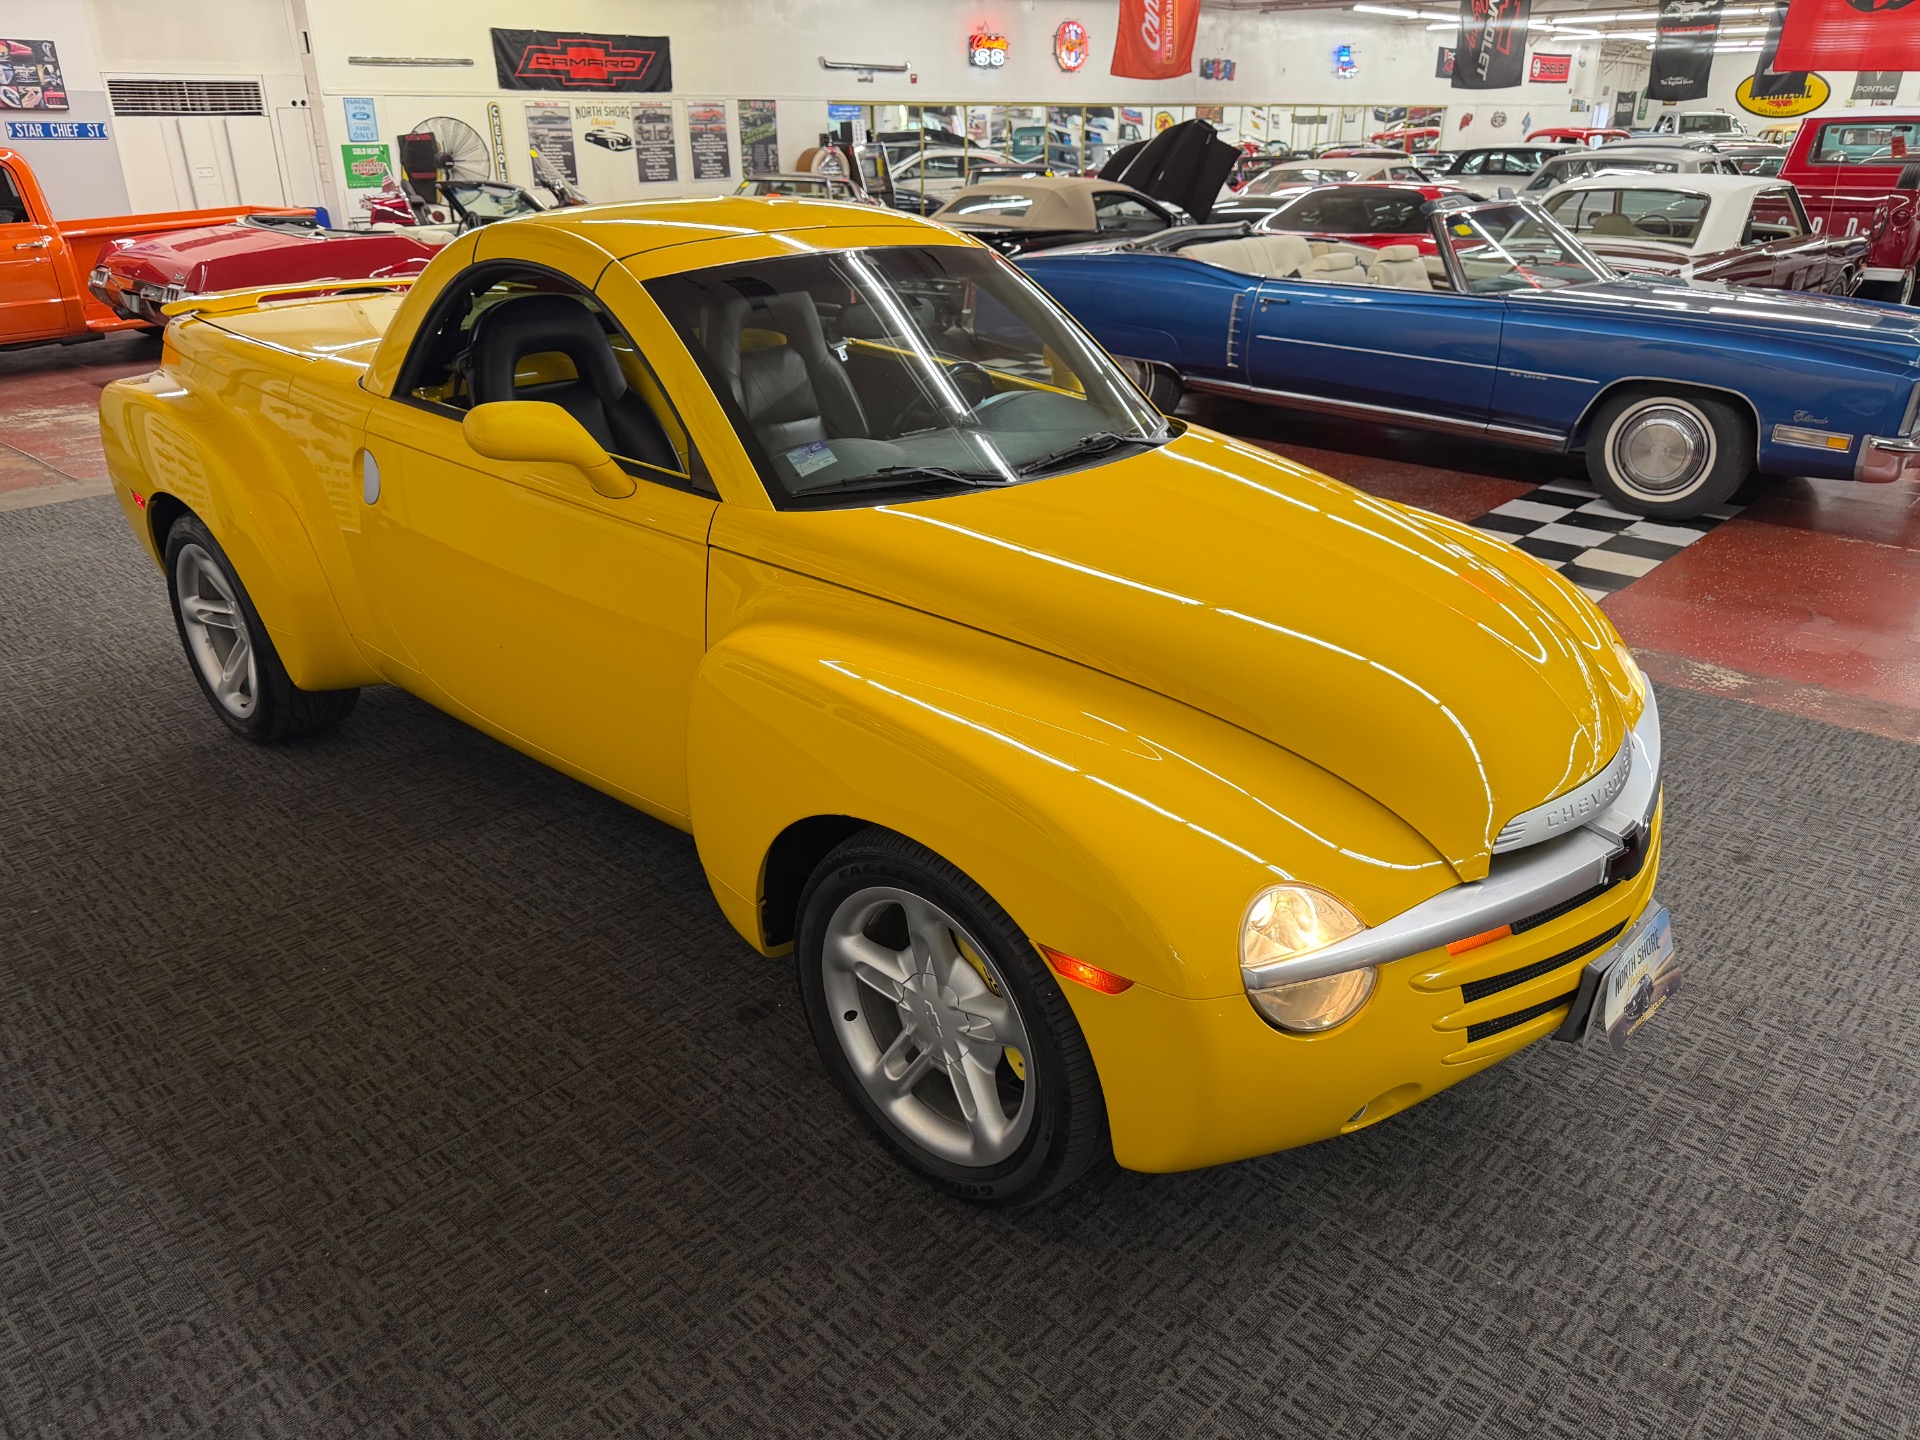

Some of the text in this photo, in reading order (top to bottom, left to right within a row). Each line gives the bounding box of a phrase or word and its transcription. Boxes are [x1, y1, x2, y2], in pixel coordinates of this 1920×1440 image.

[536, 56, 636, 69] CAMARO
[974, 48, 1005, 66] SS
[1540, 61, 1569, 75] SHELBY
[575, 106, 631, 120] NORTH SHORE
[15, 123, 100, 138] STAR CHIEF ST
[492, 106, 508, 183] CHEVROLE
[1545, 746, 1632, 830] CHEVROLET
[1614, 926, 1661, 998] NORTH SHORE
